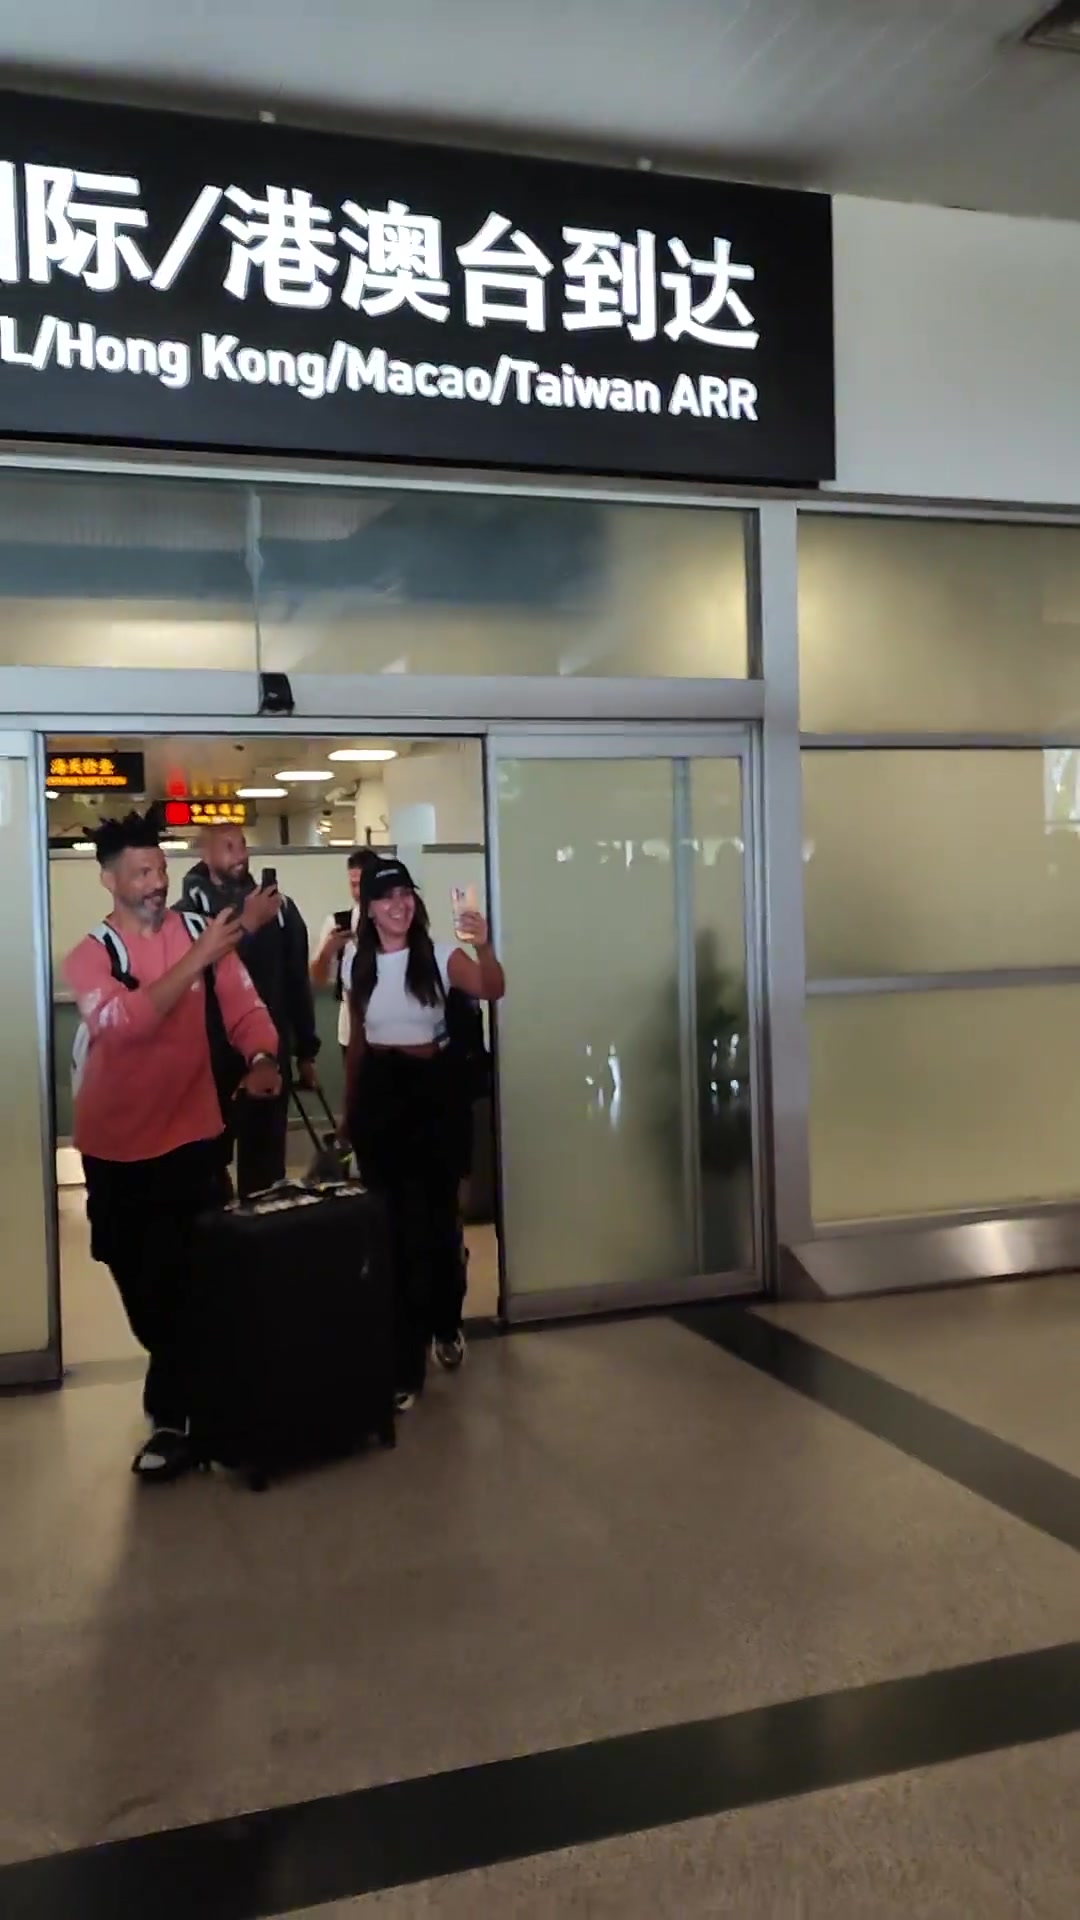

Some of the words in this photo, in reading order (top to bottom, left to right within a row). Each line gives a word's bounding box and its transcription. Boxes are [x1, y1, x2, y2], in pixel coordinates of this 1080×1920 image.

[0, 160, 760, 350] 际/港澳台到达
[0, 314, 191, 389] L/Hong
[201, 332, 662, 414] Kong/Macao/Taiwan
[668, 373, 759, 421] ARR
